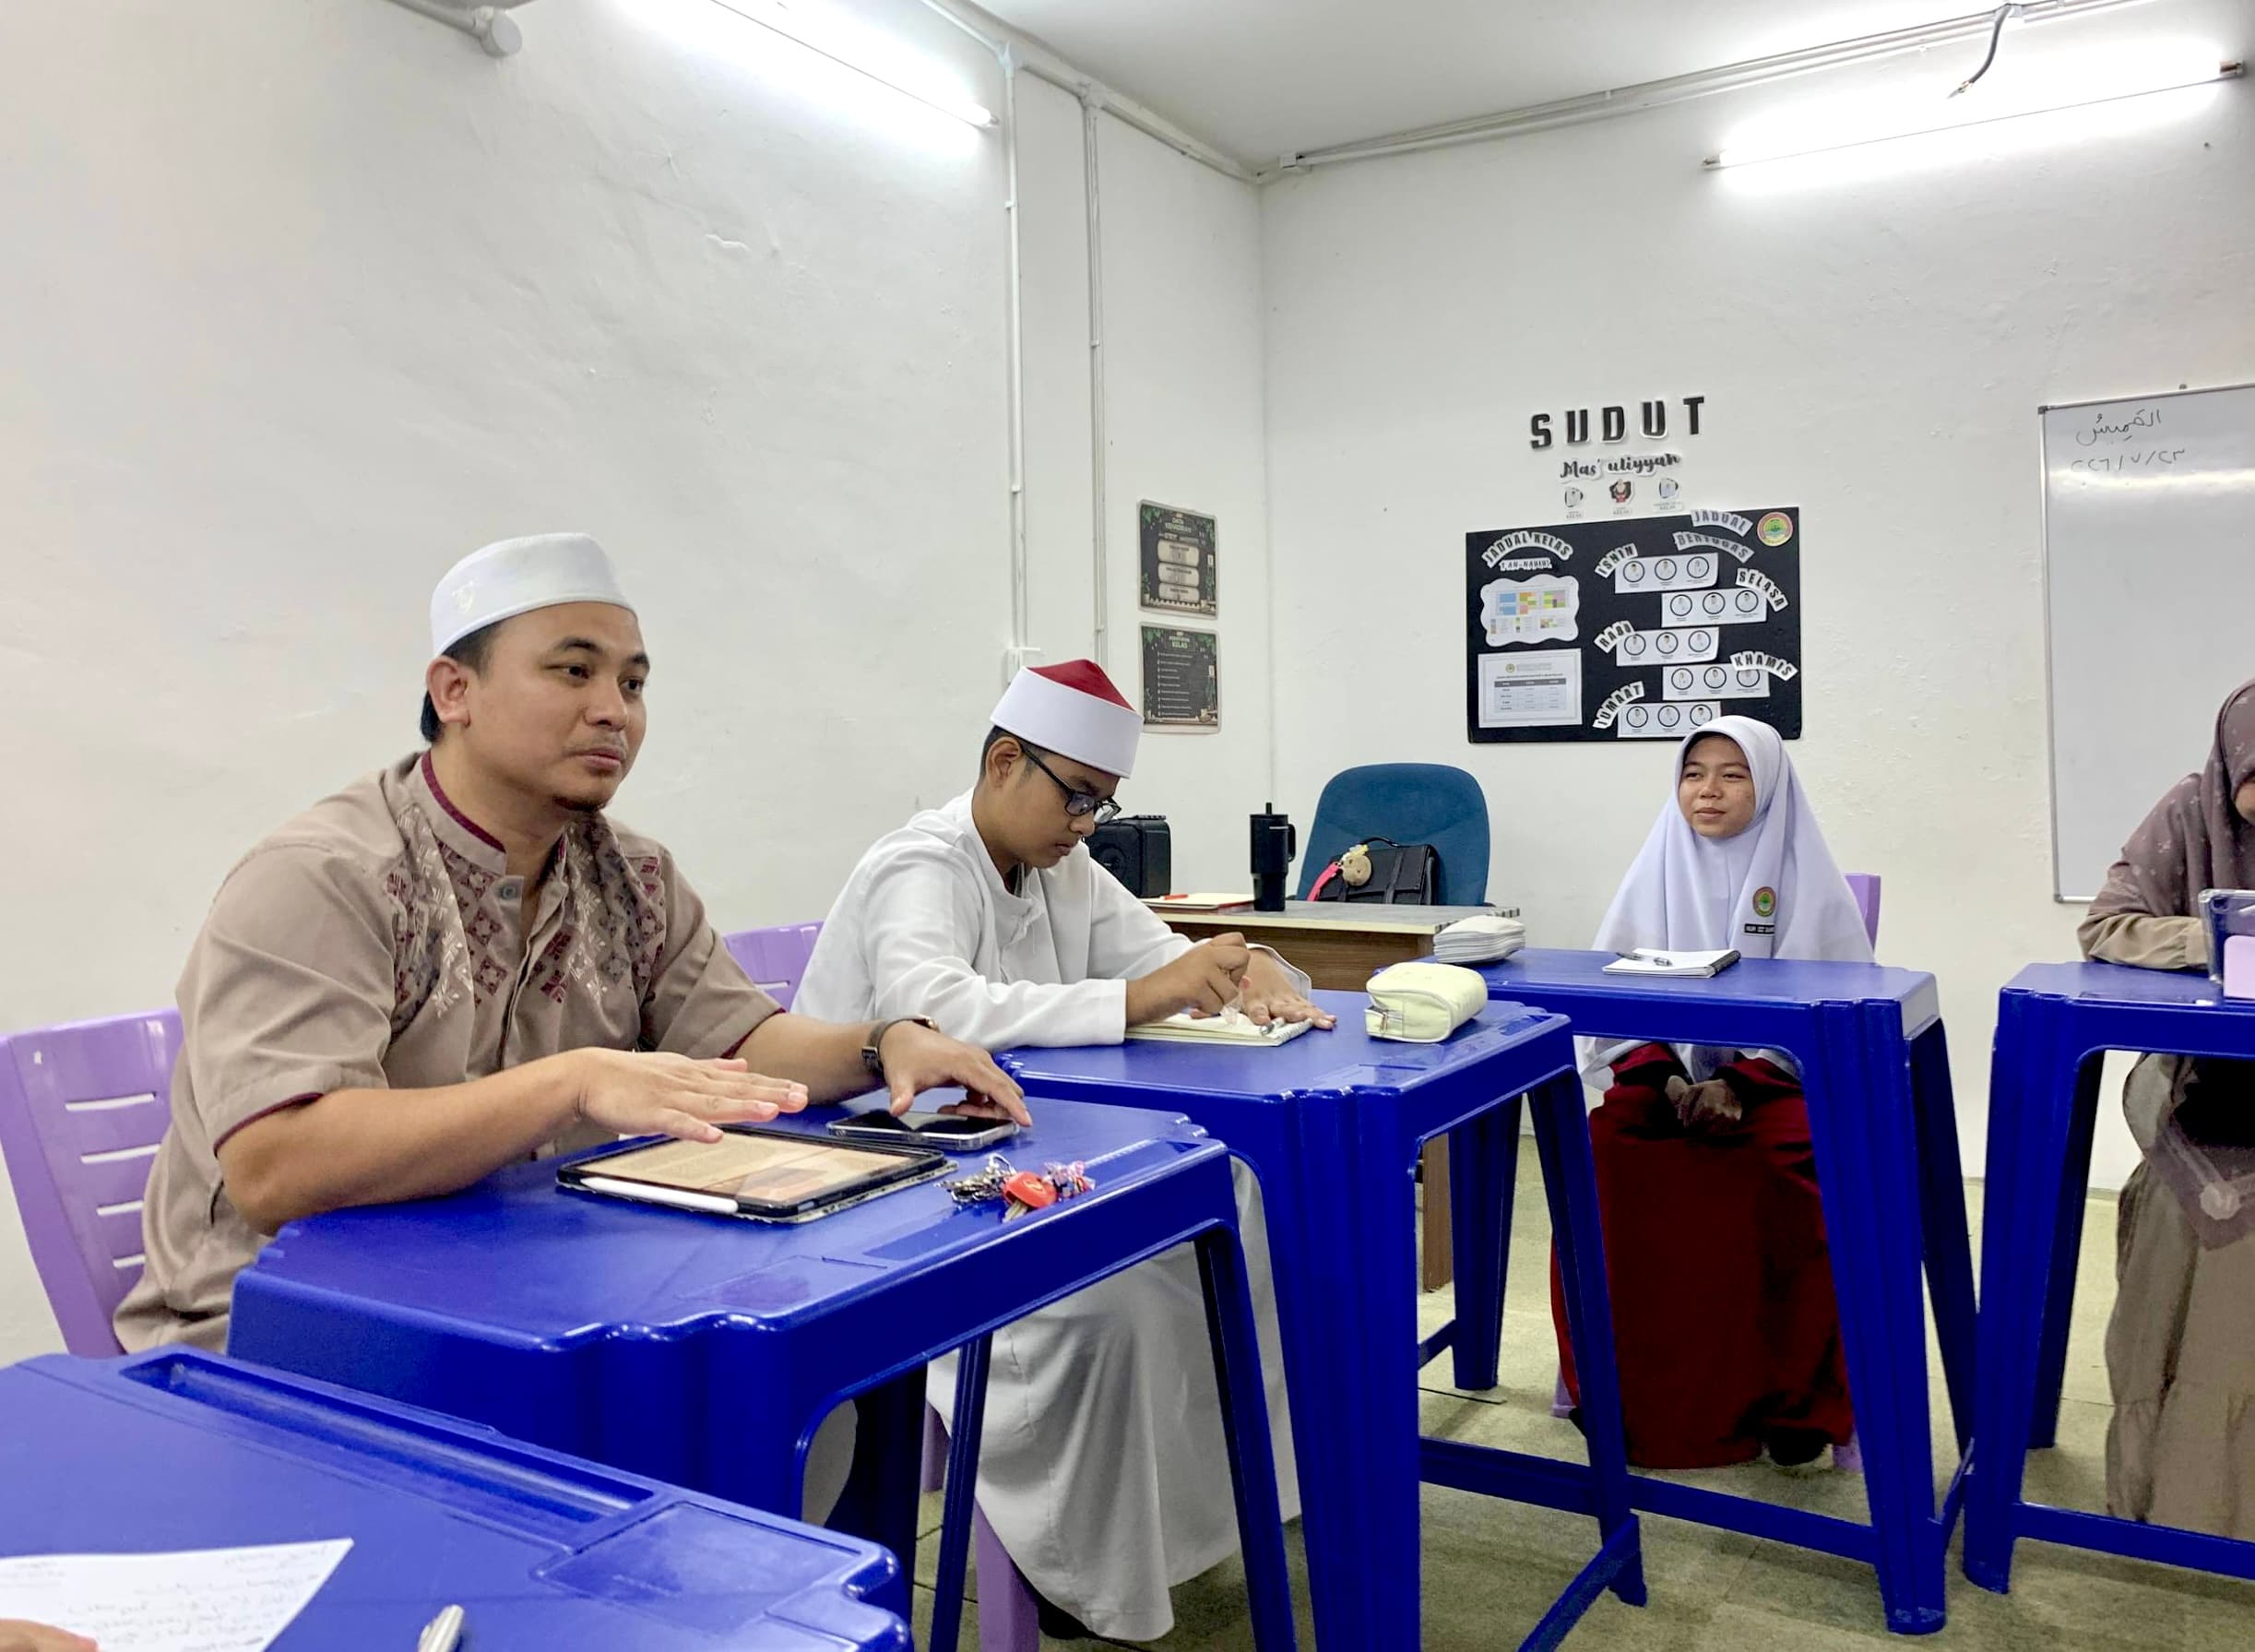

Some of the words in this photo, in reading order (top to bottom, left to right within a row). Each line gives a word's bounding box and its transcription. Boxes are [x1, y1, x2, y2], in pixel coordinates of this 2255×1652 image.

[1530, 396, 1705, 449] SUDUT
[1693, 509, 1747, 532] JADUAL
[1484, 532, 1528, 563] JADUAL
[1533, 532, 1571, 556] KELAS
[1597, 545, 1636, 575] ISNIN
[1738, 569, 1786, 609] SELASA
[1598, 622, 1632, 648] RABU
[1734, 653, 1794, 676] KHAMIS
[1596, 683, 1643, 726] JUMAAT
